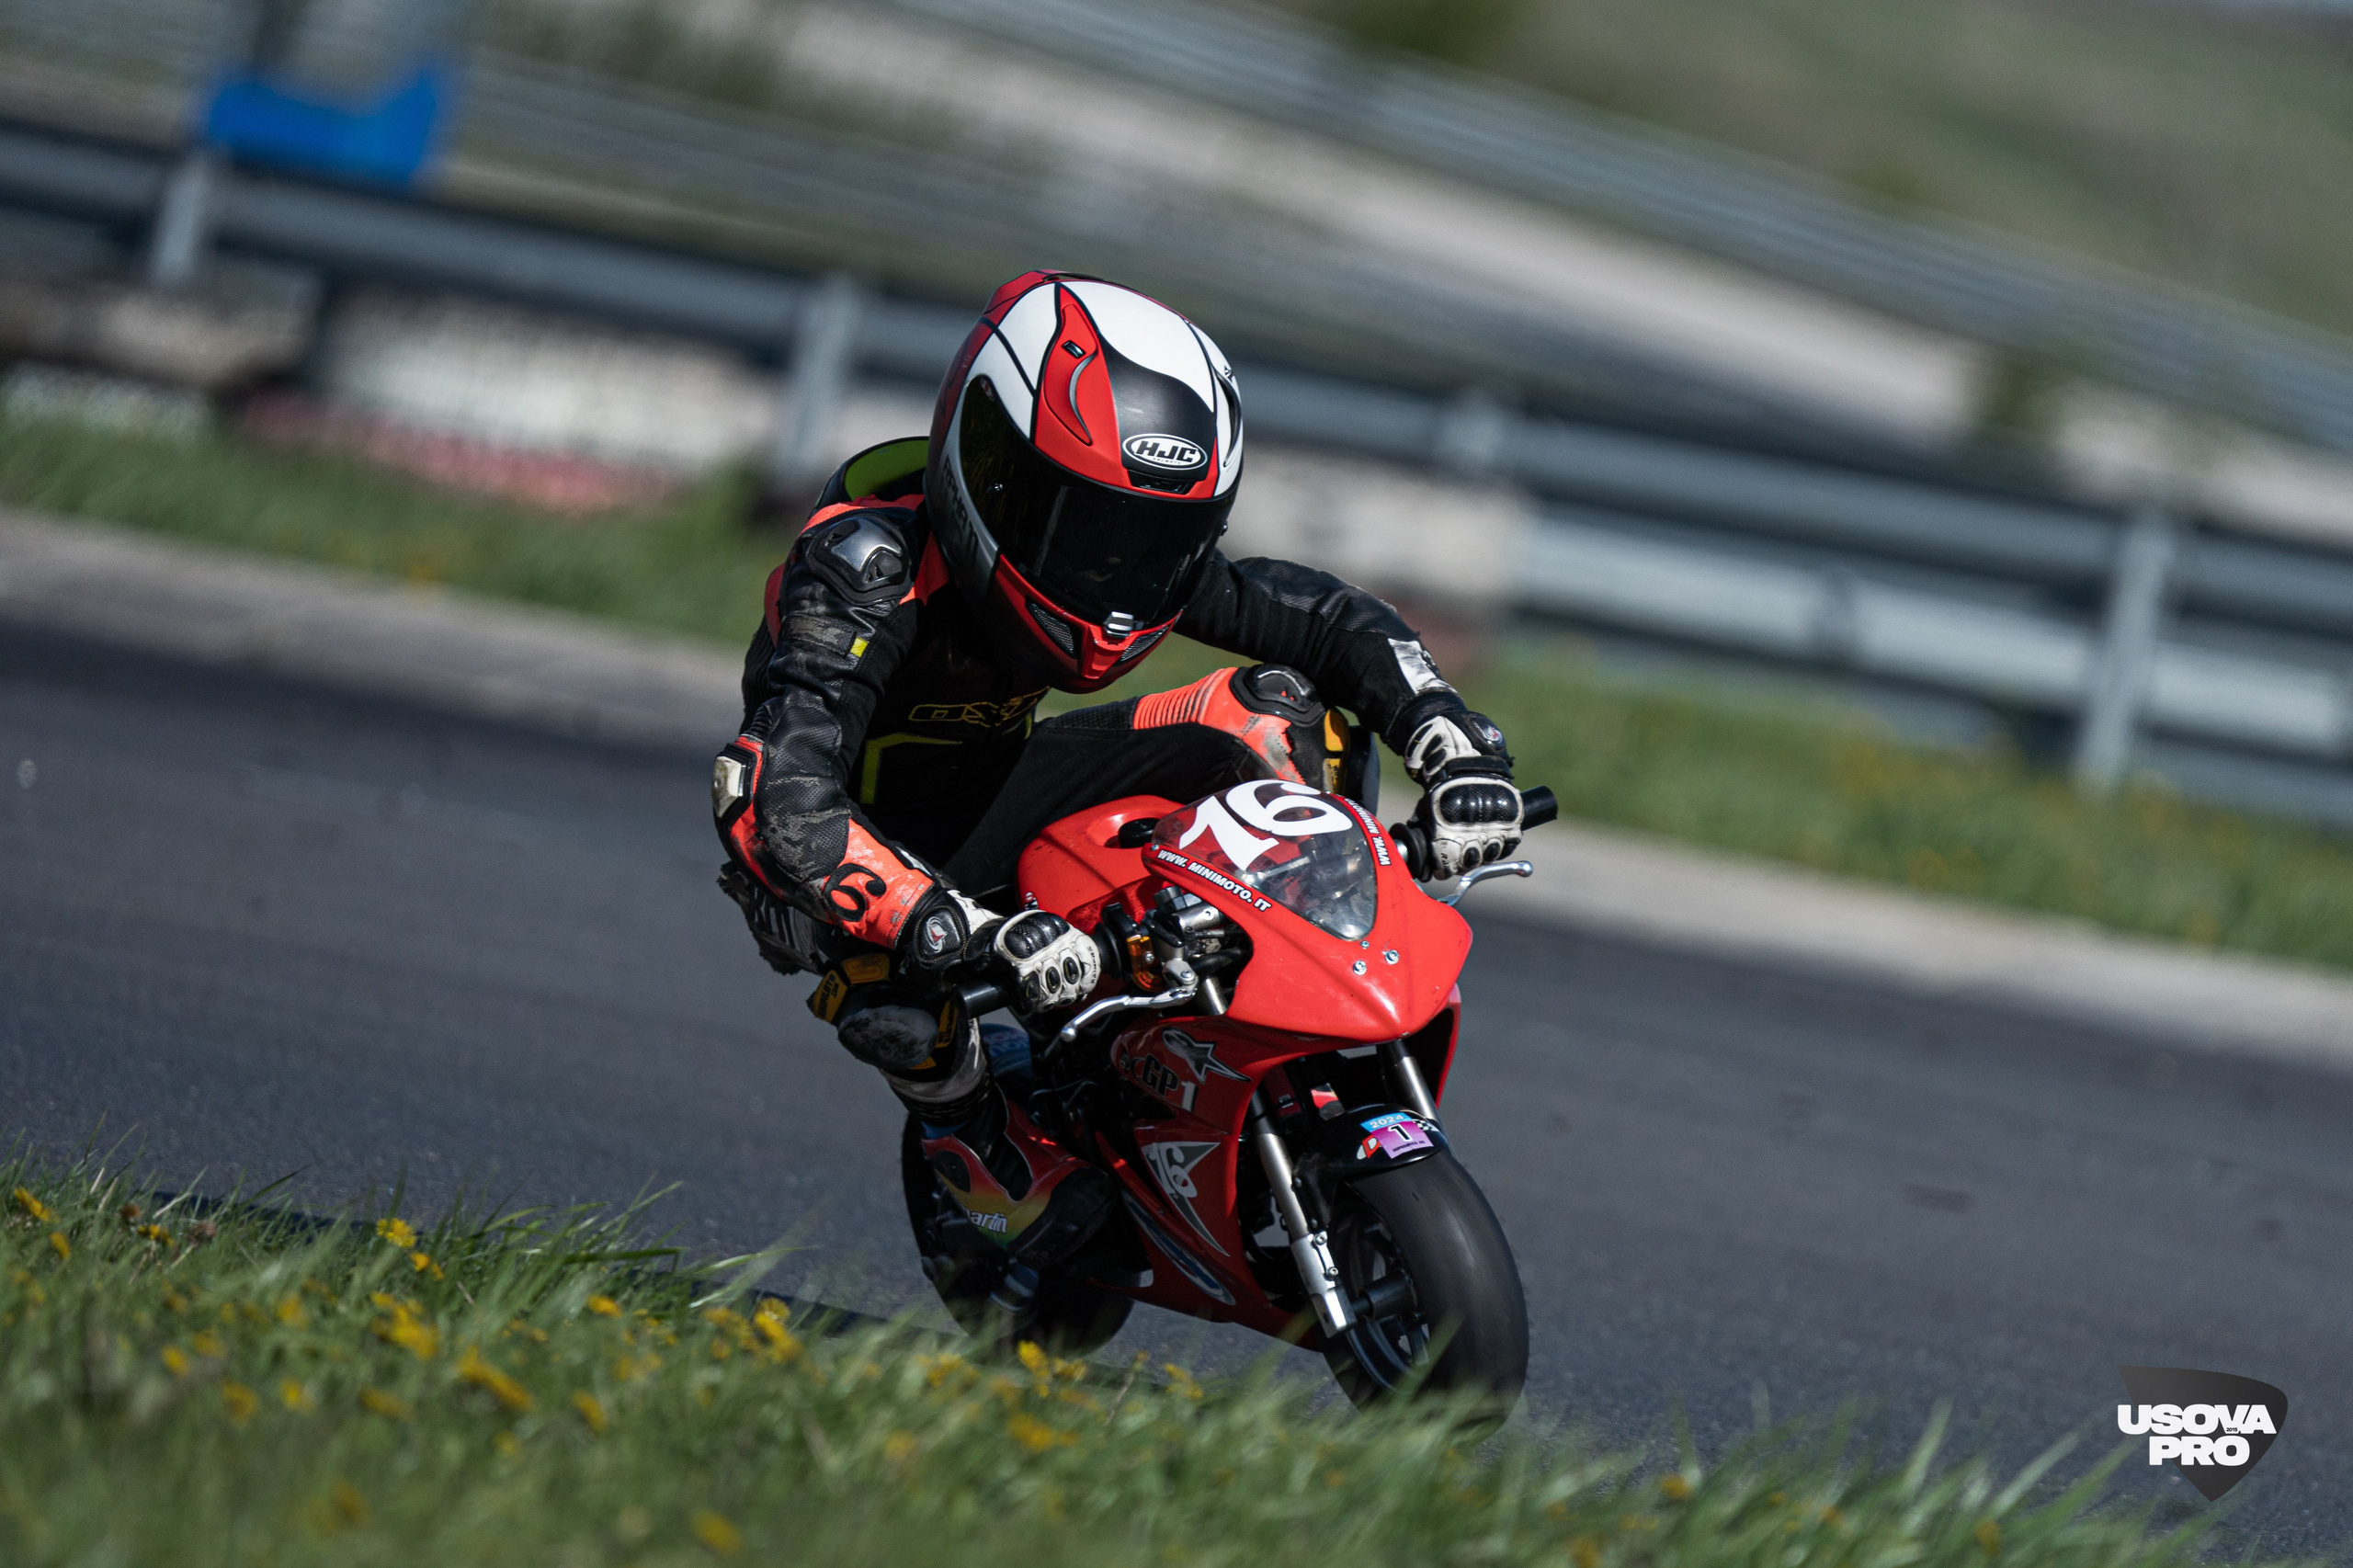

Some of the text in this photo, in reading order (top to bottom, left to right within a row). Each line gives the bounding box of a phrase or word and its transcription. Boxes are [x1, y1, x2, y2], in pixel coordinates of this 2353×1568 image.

[1136, 440, 1197, 463] HJC
[1157, 849, 1188, 867] WWW.
[1254, 898, 1272, 911] IT
[1370, 1114, 1404, 1129] 2024
[1388, 1123, 1414, 1142] 1
[964, 1208, 1007, 1233] artin
